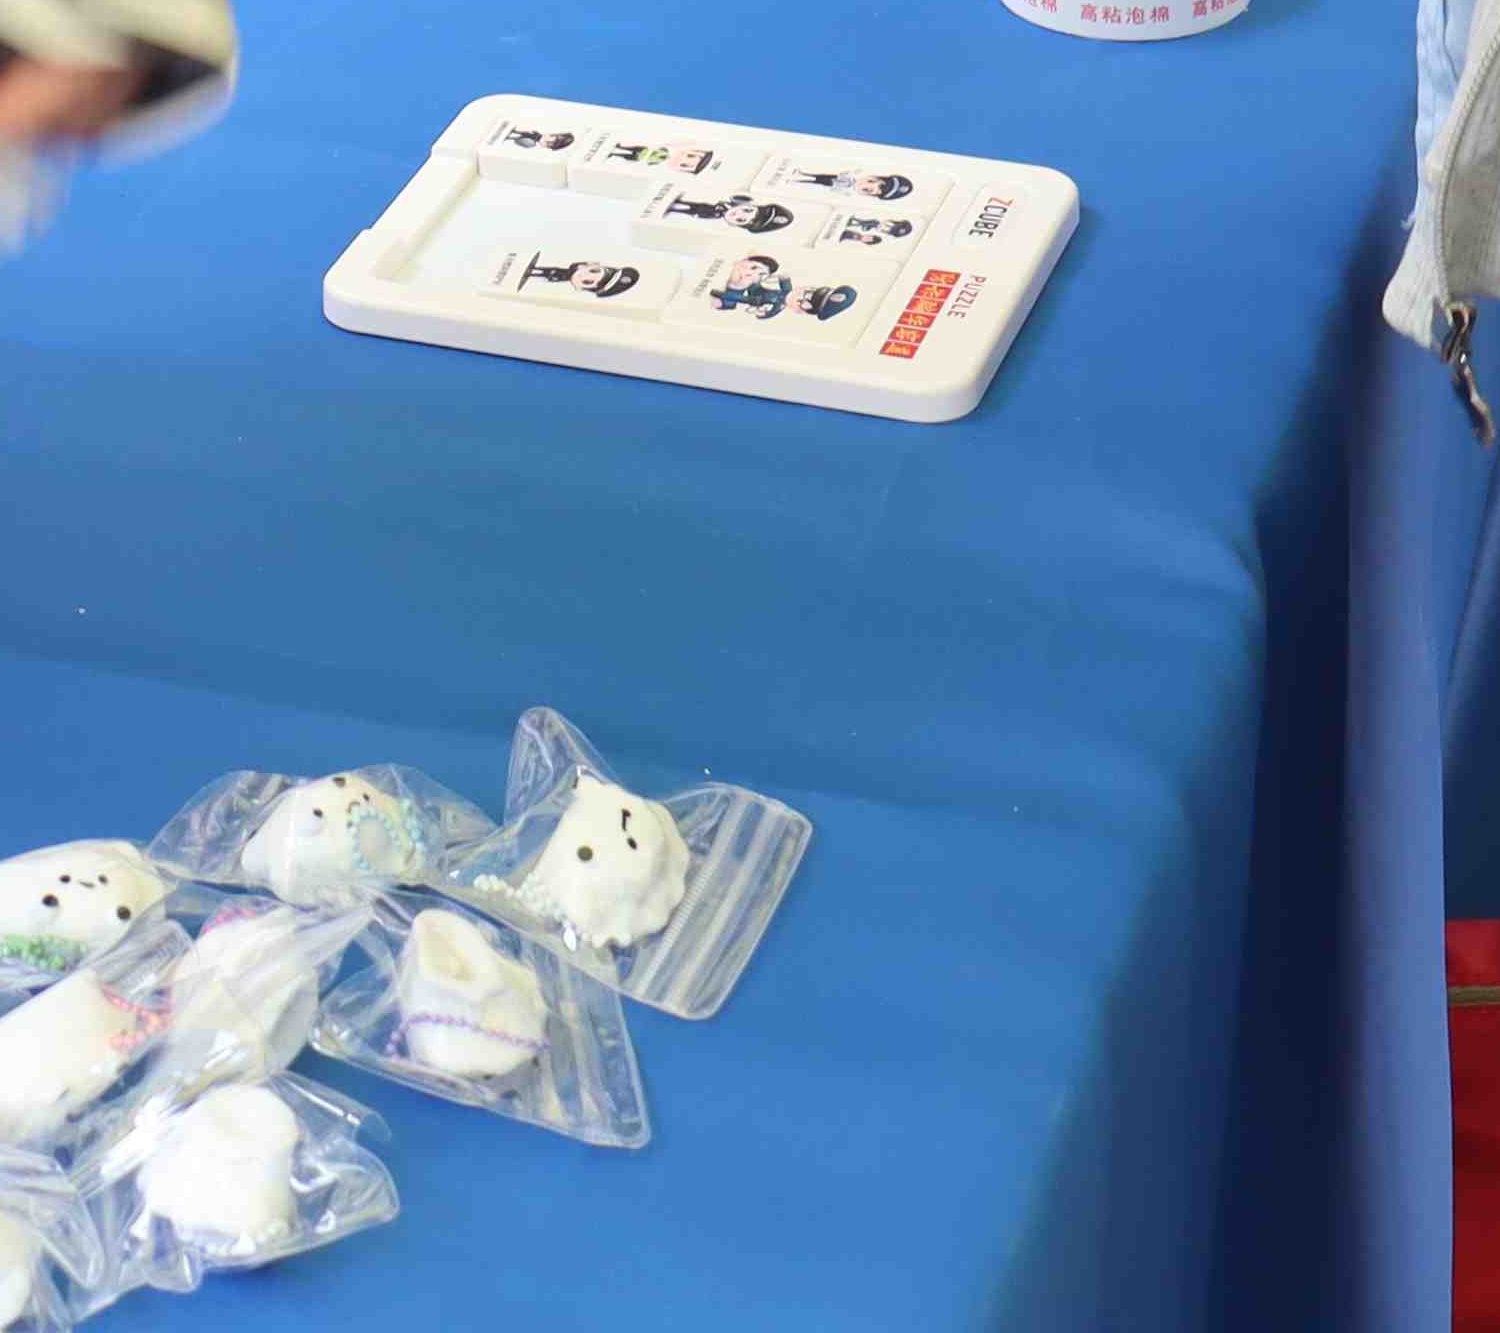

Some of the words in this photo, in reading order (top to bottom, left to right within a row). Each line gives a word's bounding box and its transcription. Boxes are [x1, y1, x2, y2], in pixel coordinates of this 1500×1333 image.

[1080, 2, 1170, 25] 高粘泡棉
[968, 196, 1015, 239] ZCUBE
[947, 274, 987, 319] PUZZLE
